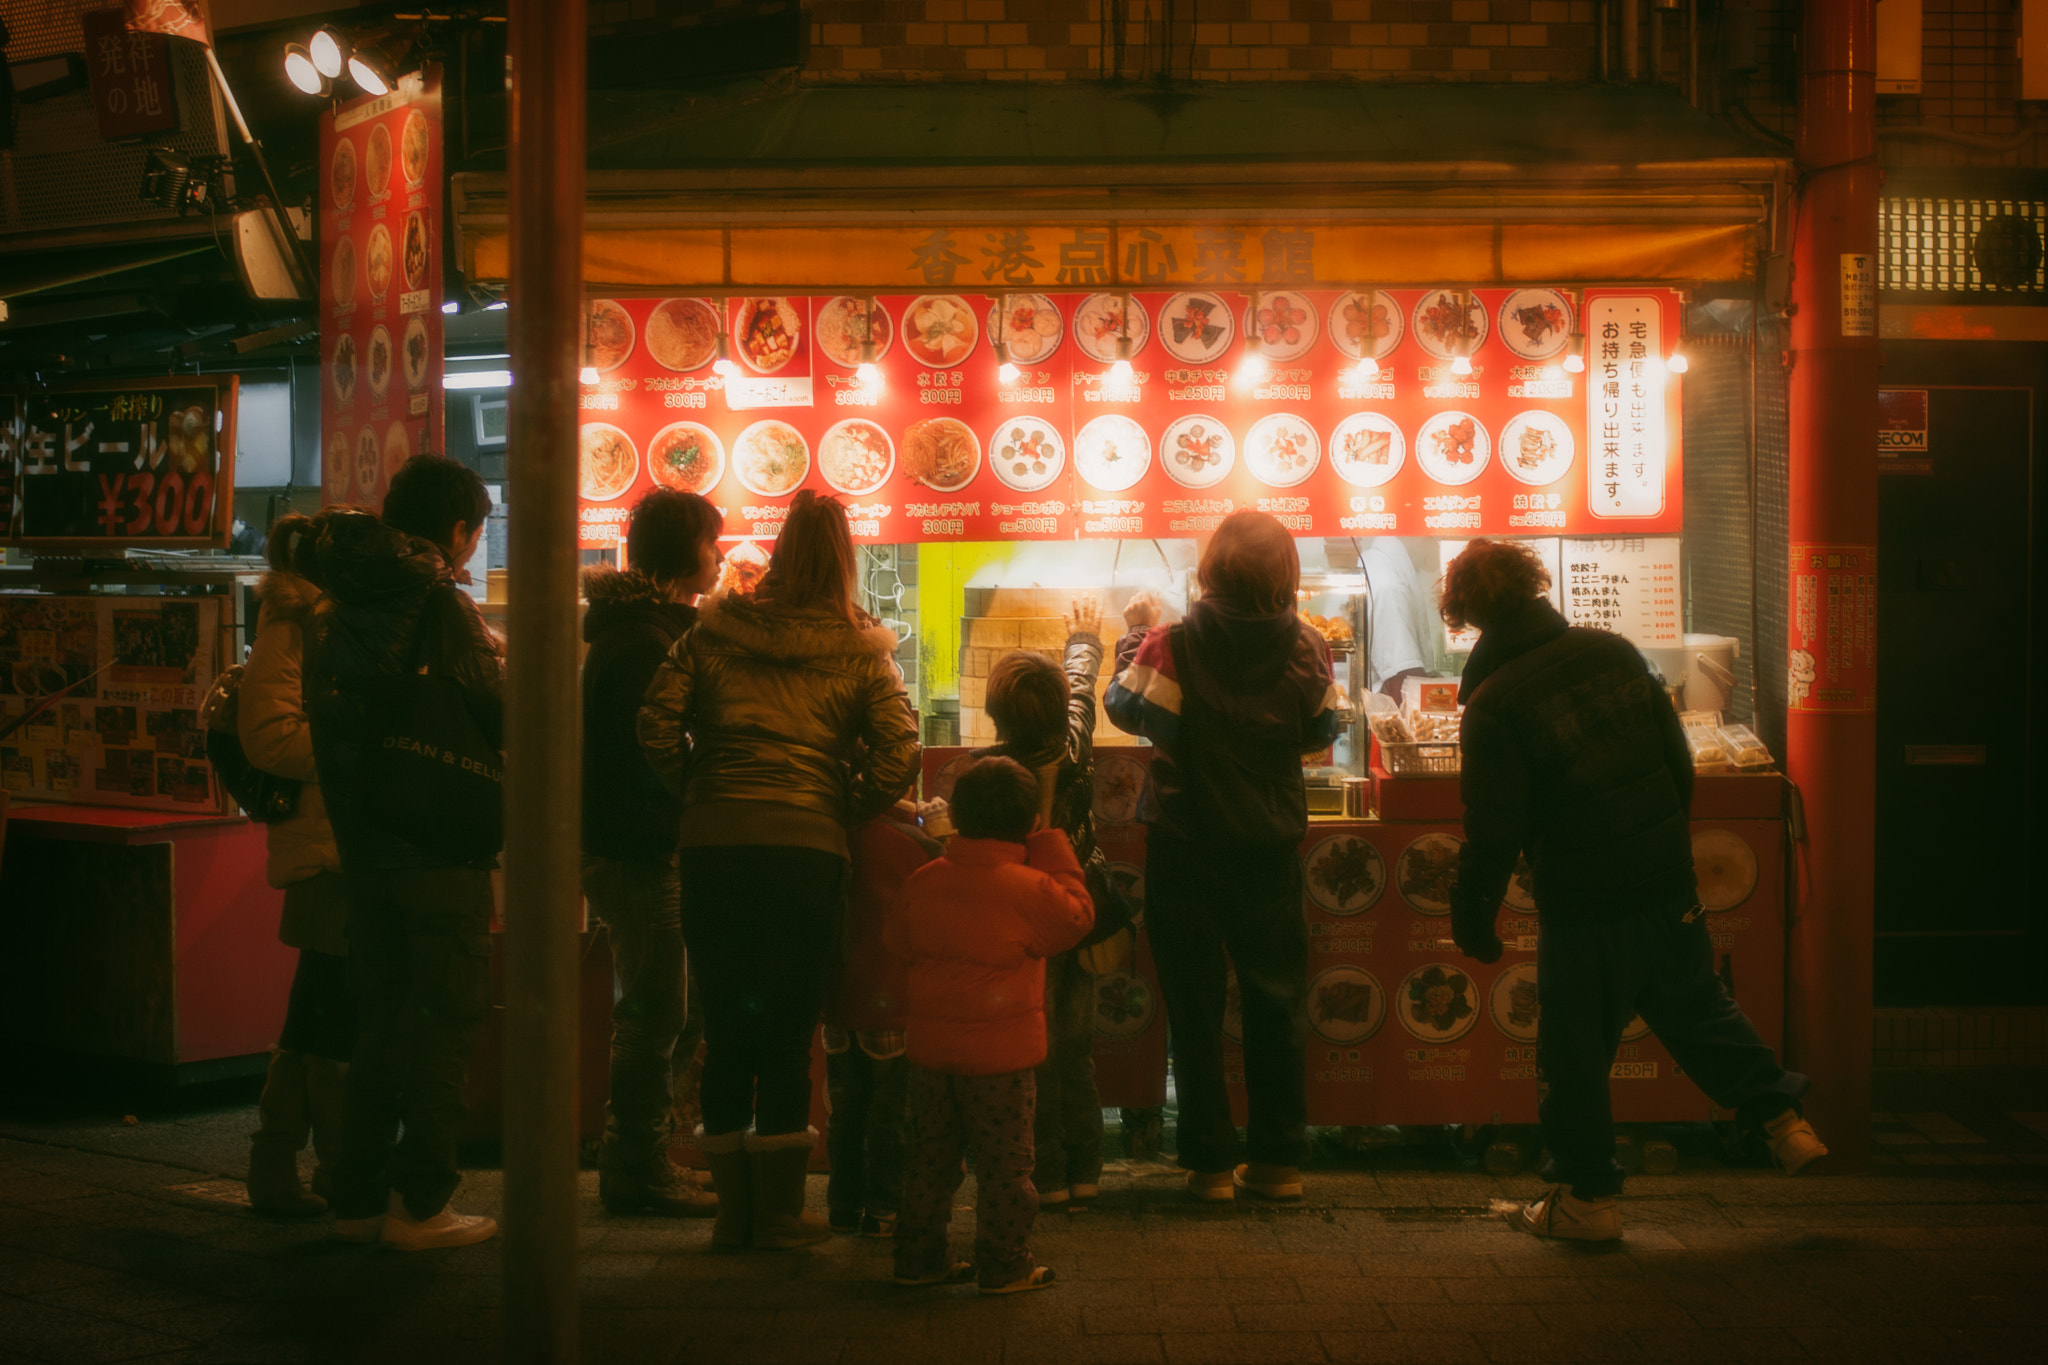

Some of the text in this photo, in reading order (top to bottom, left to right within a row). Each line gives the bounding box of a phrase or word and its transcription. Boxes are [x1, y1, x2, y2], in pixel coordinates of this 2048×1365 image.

[98, 33, 154, 77] 発祥
[108, 76, 162, 116] の地
[907, 229, 1316, 285] 香港点心菜館
[644, 377, 724, 391] フカヒレラーメン
[917, 372, 963, 386] 水餃子
[1165, 370, 1227, 383] 中華チマキ
[665, 392, 706, 408] 300円
[835, 390, 877, 405] 300円
[921, 388, 961, 404] 300円
[998, 387, 1055, 402] 1コ150円
[1169, 385, 1225, 401] 1コ250円
[92, 394, 163, 422] 一番搾り
[24, 420, 168, 475] 生ビール
[97, 471, 214, 536] ¥300
[1163, 499, 1233, 513] ニラまんじゅう
[1257, 497, 1309, 512] エビ餃子
[580, 525, 620, 540] 300円
[923, 519, 963, 534] 300円
[1000, 517, 1056, 533] 6コ500円
[1572, 574, 1629, 584] エビニラまん
[1573, 598, 1621, 607] ミニ肉まん
[1573, 609, 1622, 618] しゅうまい
[383, 736, 438, 759] DEAN
[442, 750, 456, 765] &
[1614, 1063, 1655, 1077] 250円
